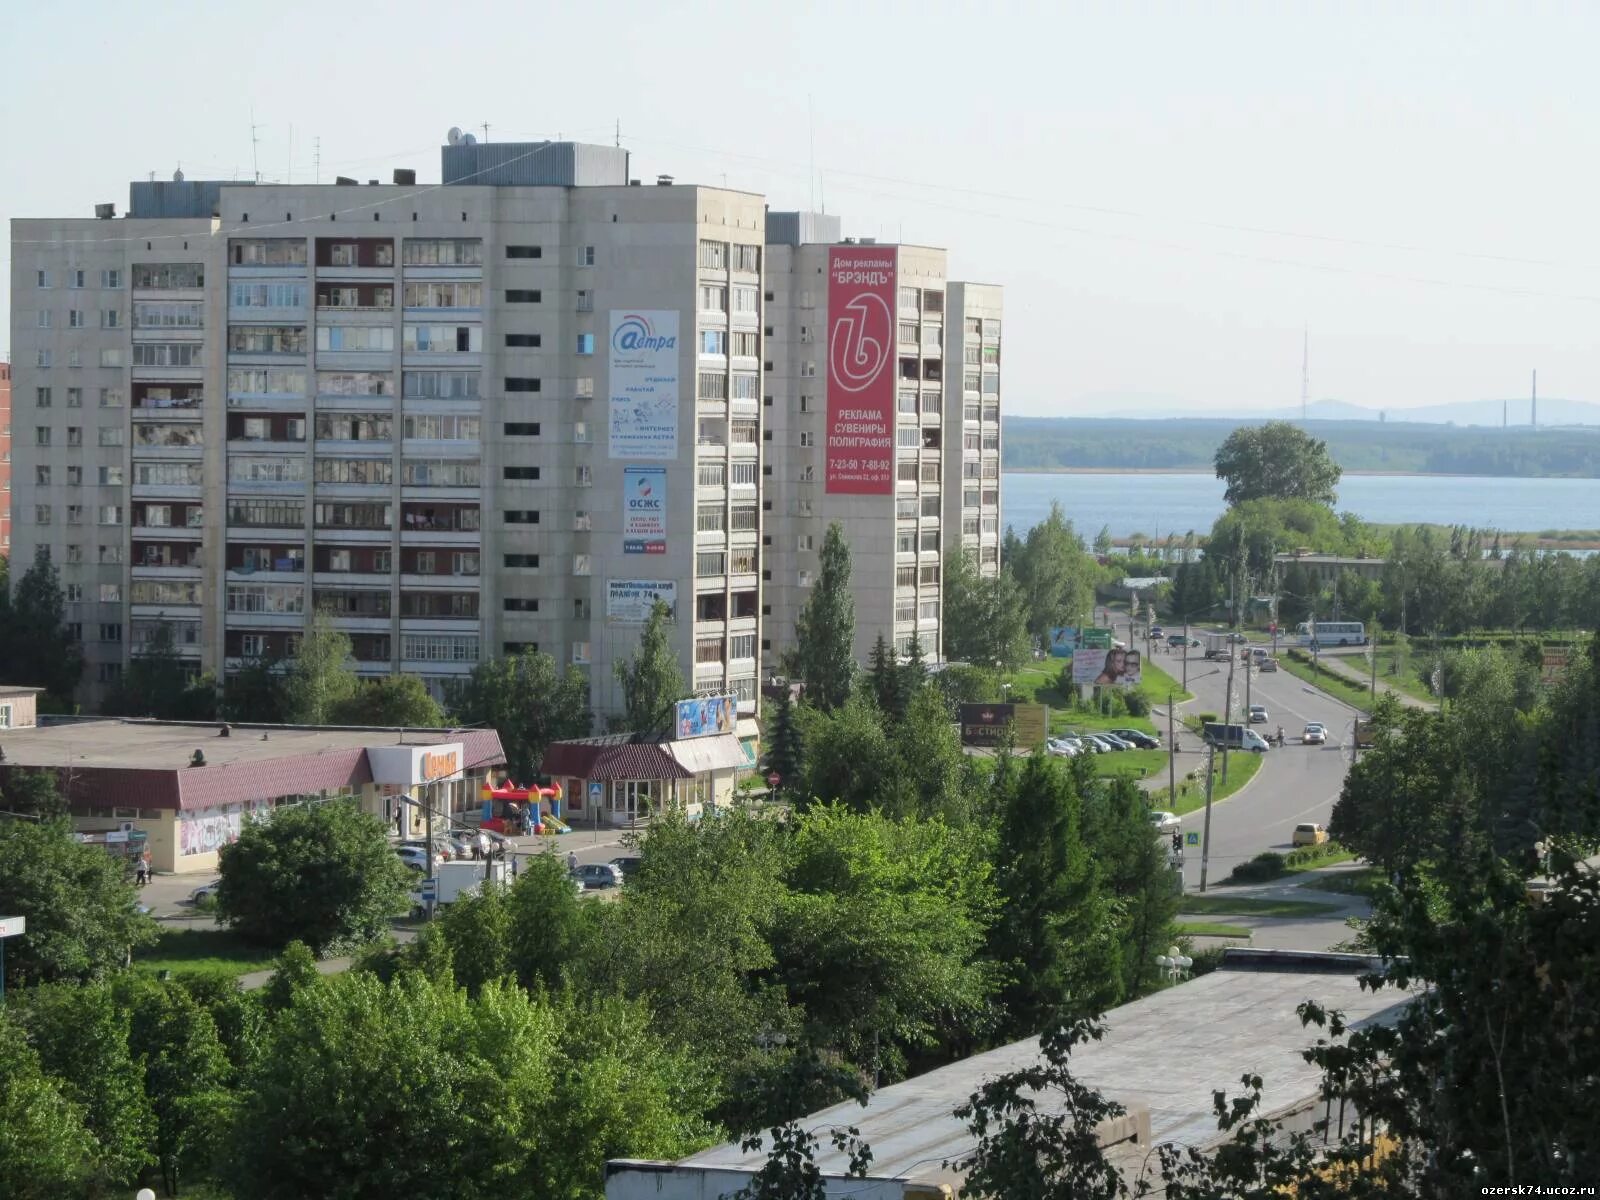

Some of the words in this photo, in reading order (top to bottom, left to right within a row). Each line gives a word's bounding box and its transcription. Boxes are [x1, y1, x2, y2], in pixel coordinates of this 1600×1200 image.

[833, 257, 852, 269] Дом
[853, 260, 893, 270] рекламы
[832, 271, 894, 287] "БРЭНДЪ"
[839, 409, 882, 420] РЕКЛАМА
[834, 423, 886, 434] СУВЕНИРЫ
[829, 436, 891, 448] ПОЛИГРАФИЯ
[629, 499, 660, 508] ОСЖС
[643, 590, 653, 599] 74
